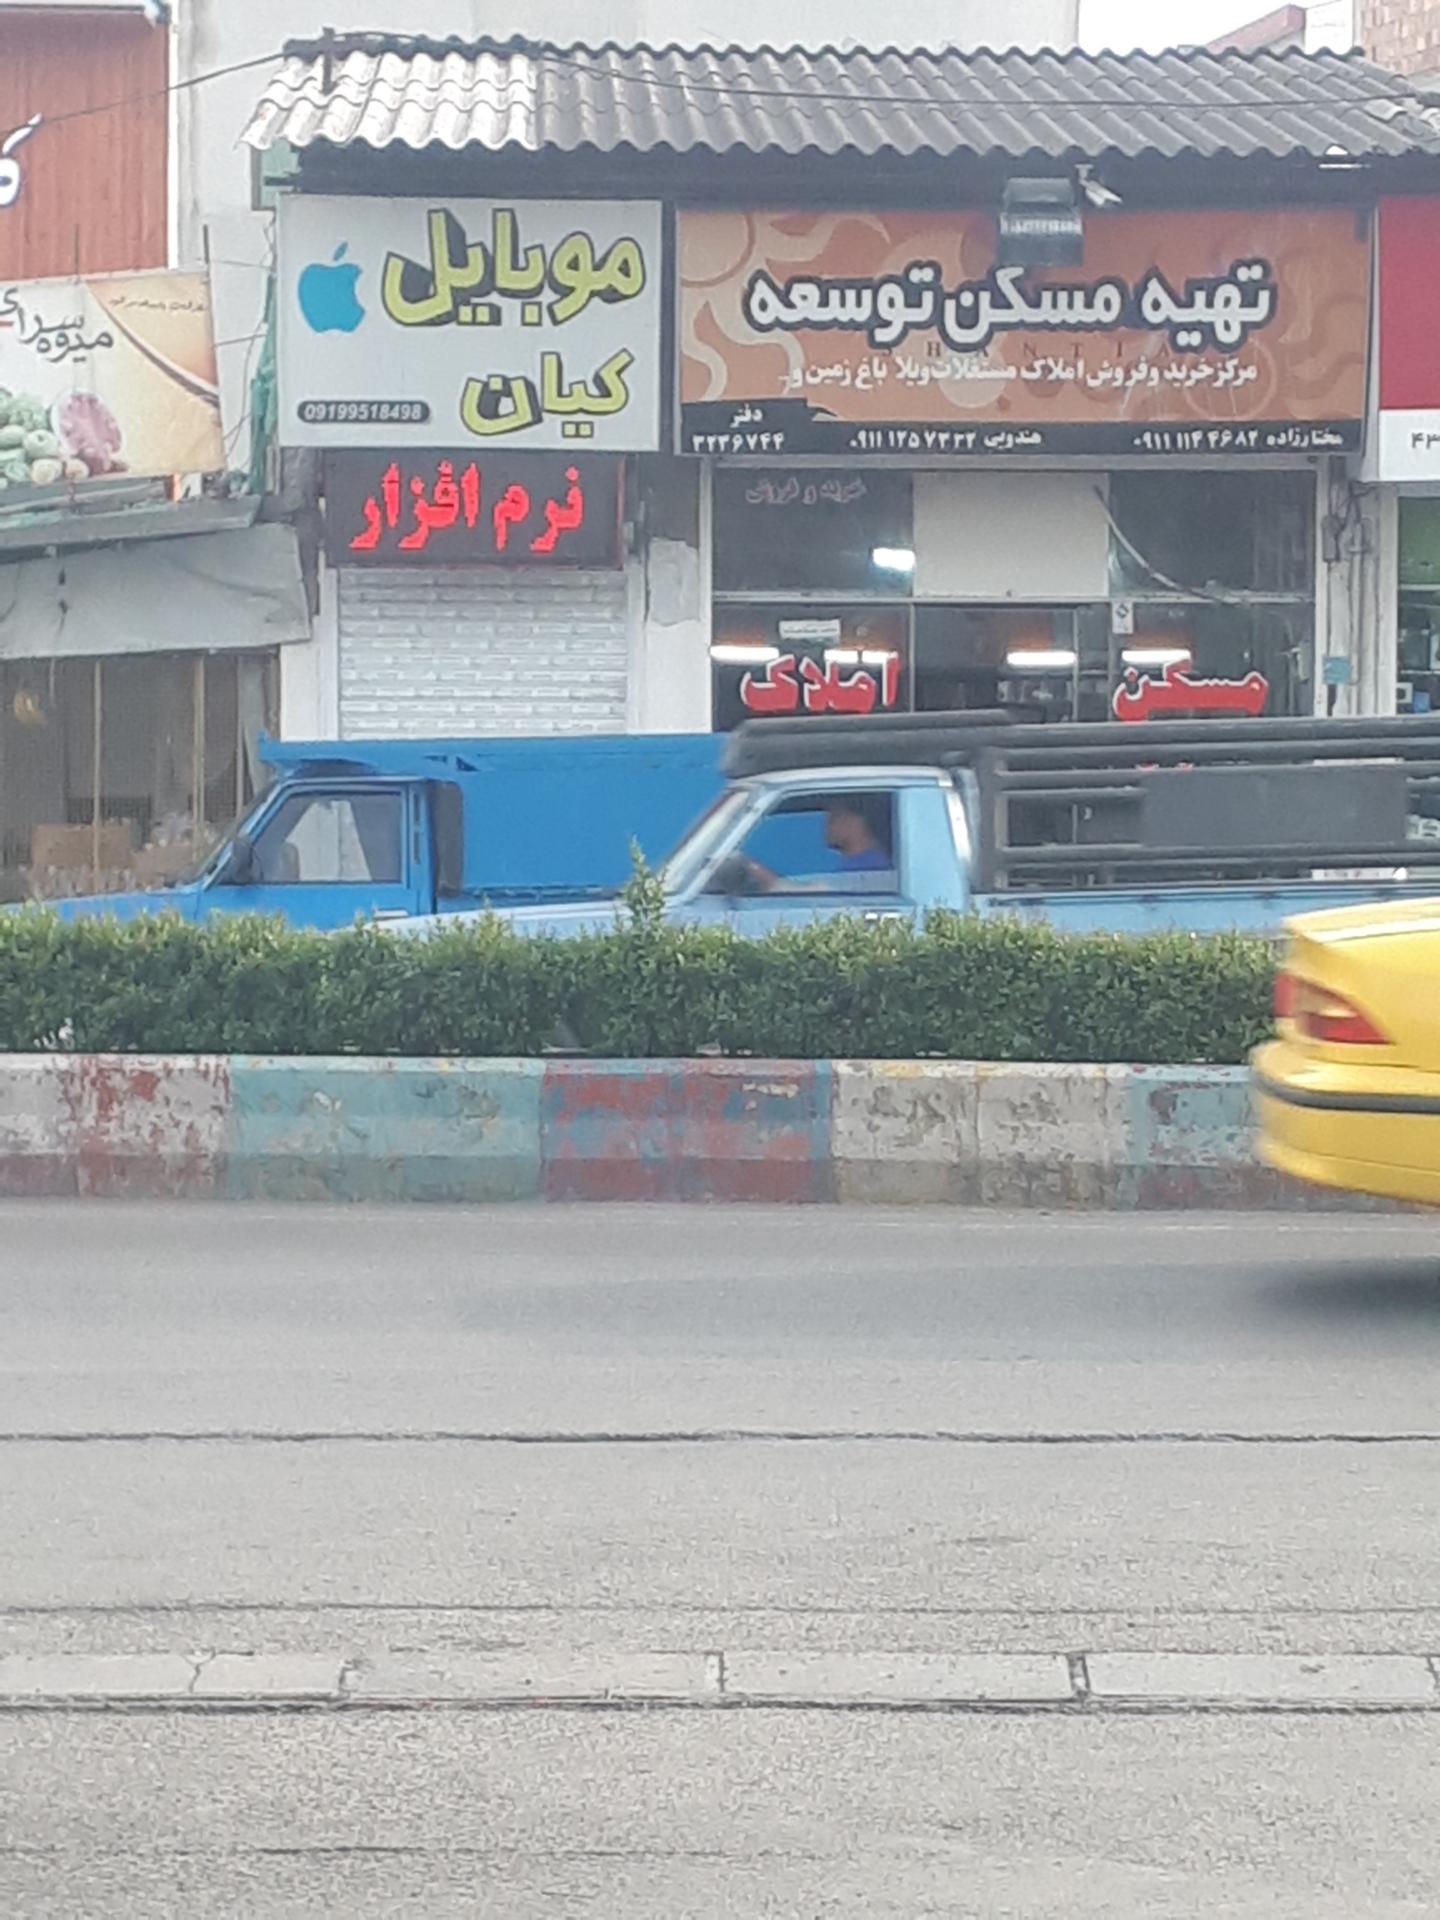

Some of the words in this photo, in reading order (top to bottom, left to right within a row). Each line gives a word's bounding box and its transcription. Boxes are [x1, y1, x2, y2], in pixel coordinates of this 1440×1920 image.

[381, 207, 646, 326] موبایل
[749, 266, 935, 342] توسعه
[944, 266, 1122, 345] مسکن
[1140, 263, 1272, 347] تهیه
[36, 331, 114, 363] میوه
[461, 347, 635, 438] کیان
[729, 403, 763, 428] دفتر
[349, 460, 480, 550] افزار
[493, 466, 585, 552] نرم
[740, 651, 899, 714] املاک
[1112, 658, 1269, 723] مسکن
